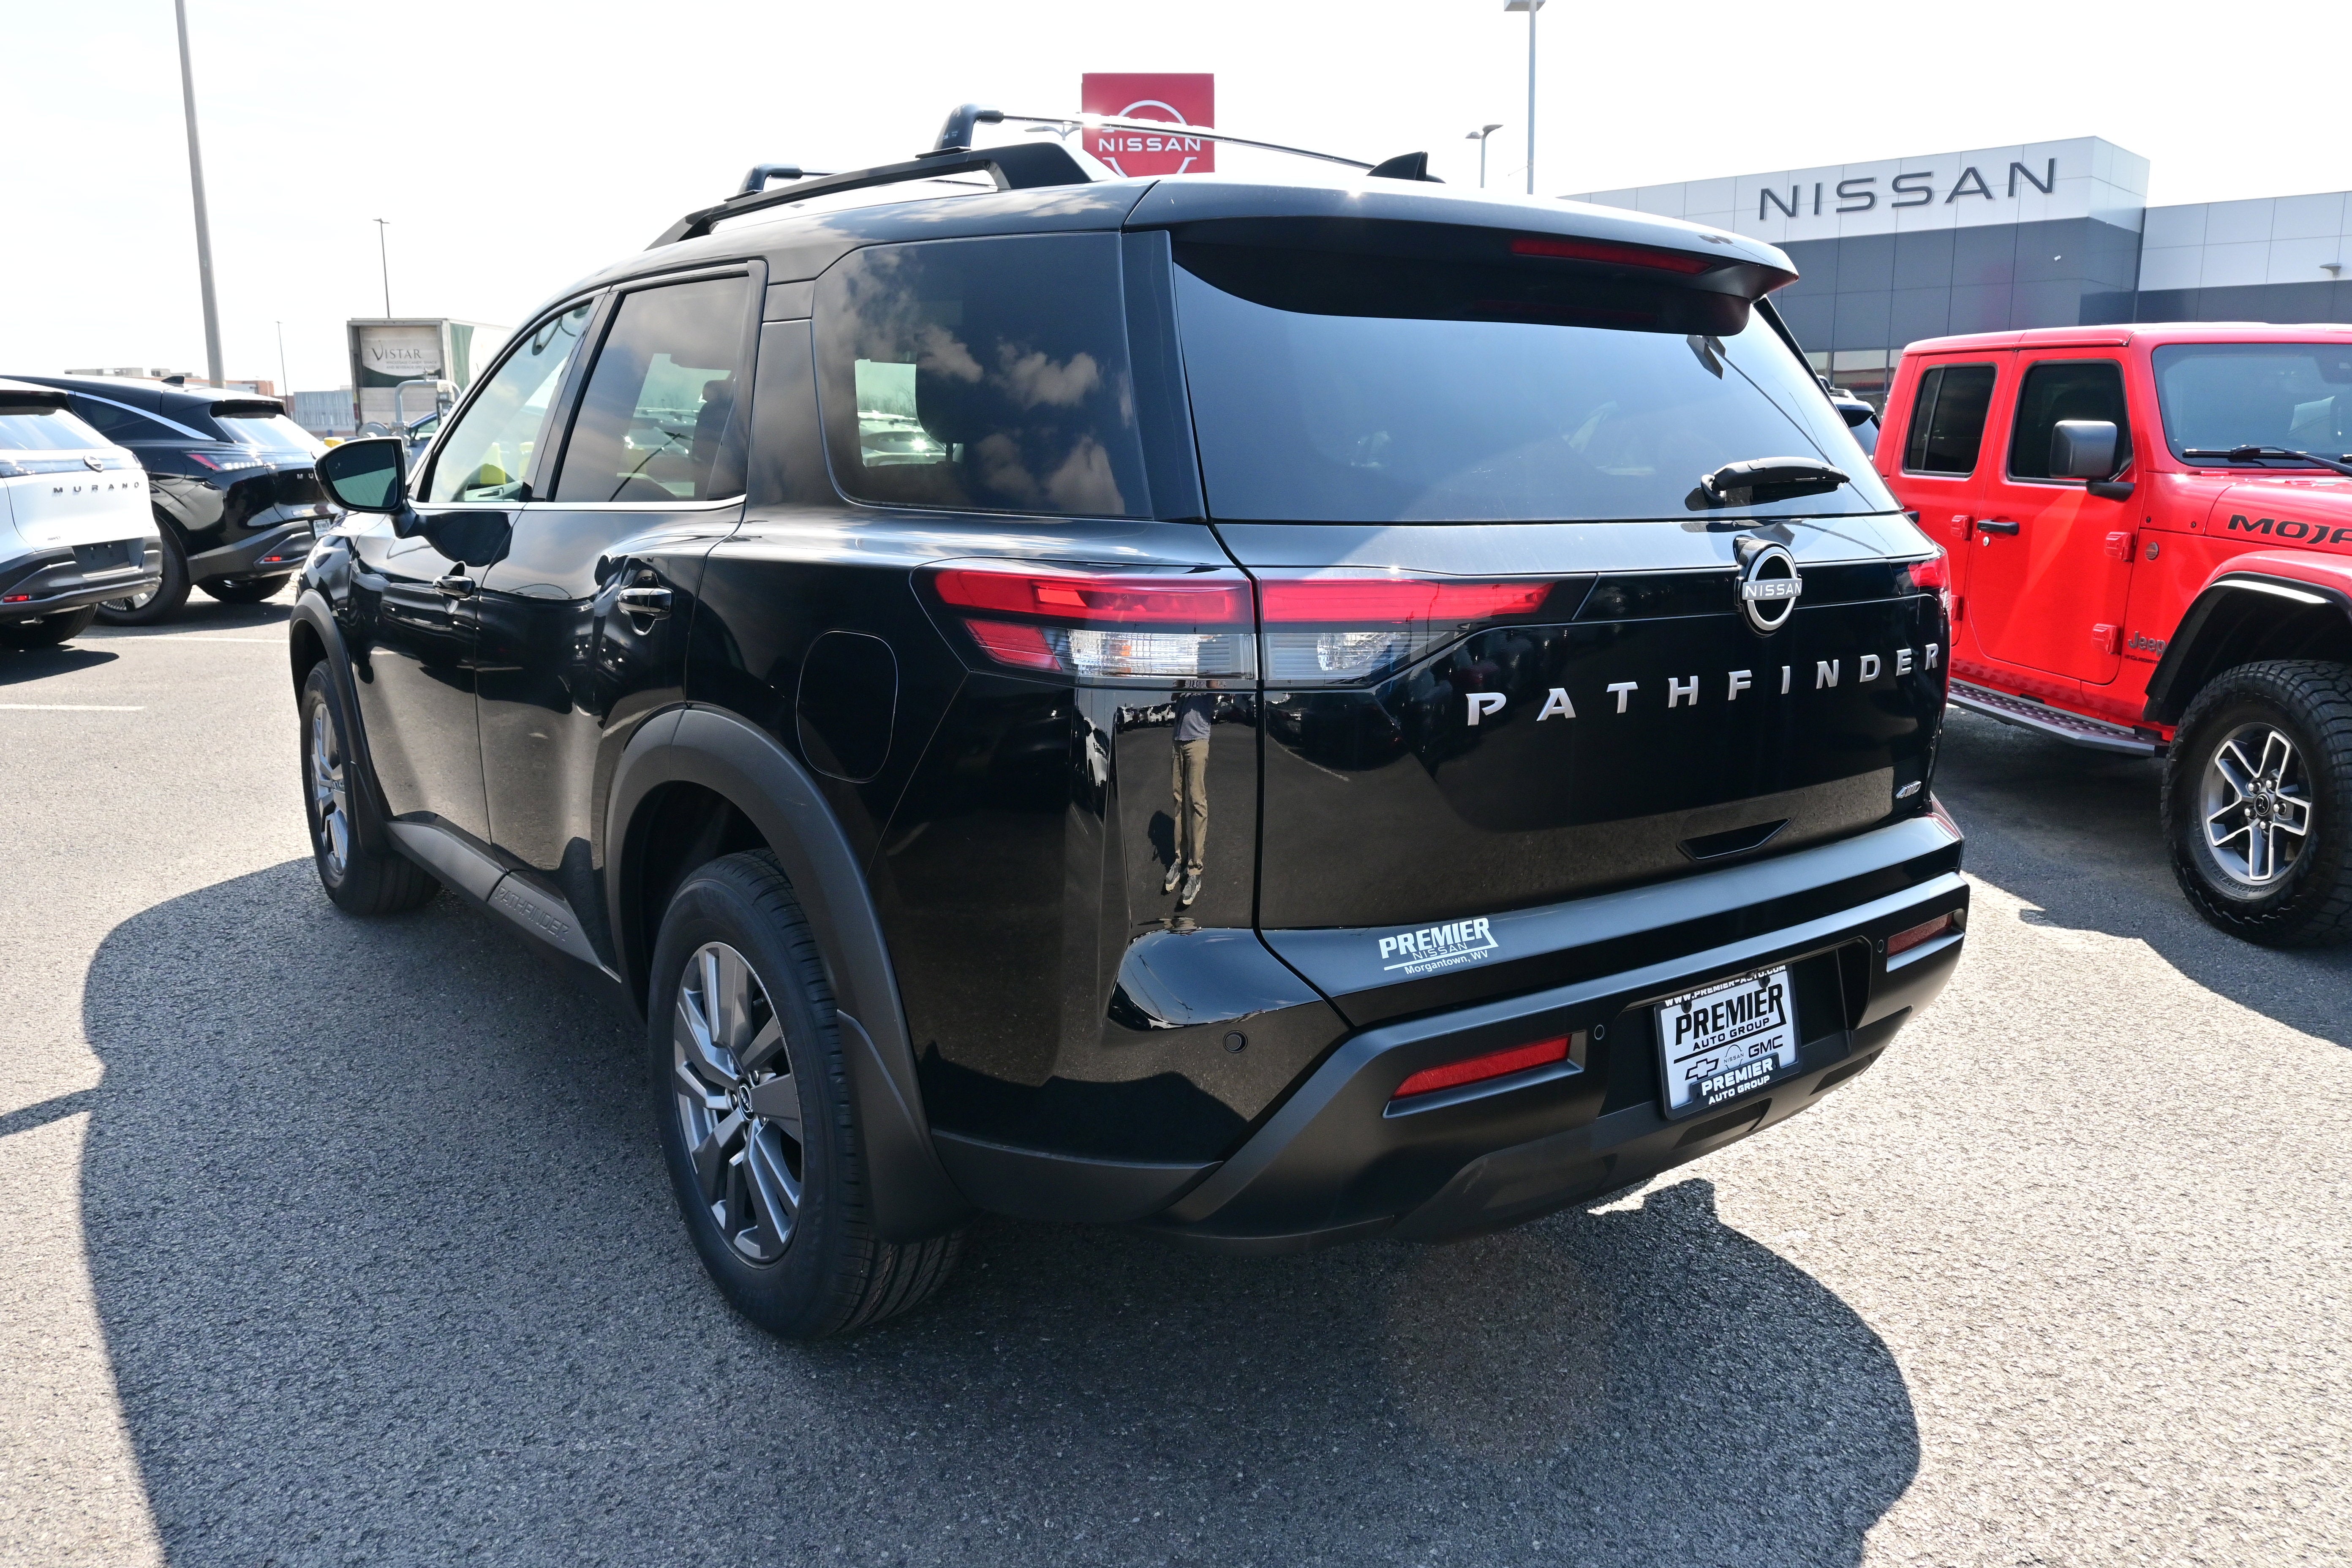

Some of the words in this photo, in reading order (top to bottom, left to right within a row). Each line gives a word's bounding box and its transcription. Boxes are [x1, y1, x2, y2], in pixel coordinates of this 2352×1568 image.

[1099, 138, 1200, 152] NISSAN
[1759, 158, 2057, 221] NISSAN
[371, 340, 421, 361] VISTAR
[54, 482, 139, 493] MURANO
[1745, 582, 1802, 598] NISSAN
[2128, 631, 2167, 657] Jeep
[1467, 643, 1939, 726] PATHFINDER
[495, 886, 569, 941] PATHFINDER
[1379, 917, 1499, 959] PREMIER
[1412, 942, 1468, 960] NISSAN
[1404, 955, 1471, 975] Morgantown,
[1470, 950, 1488, 961] WV
[1675, 983, 1786, 1045] PREMIER
[1693, 1033, 1725, 1051] AUTO
[1729, 1018, 1770, 1038] GROUP
[1748, 1035, 1783, 1058] GMC
[1724, 1053, 1744, 1064] NISSAN
[1701, 1058, 1773, 1096] PREMIER
[1708, 1089, 1735, 1105] AUTO
[1737, 1075, 1770, 1094] GROUP
